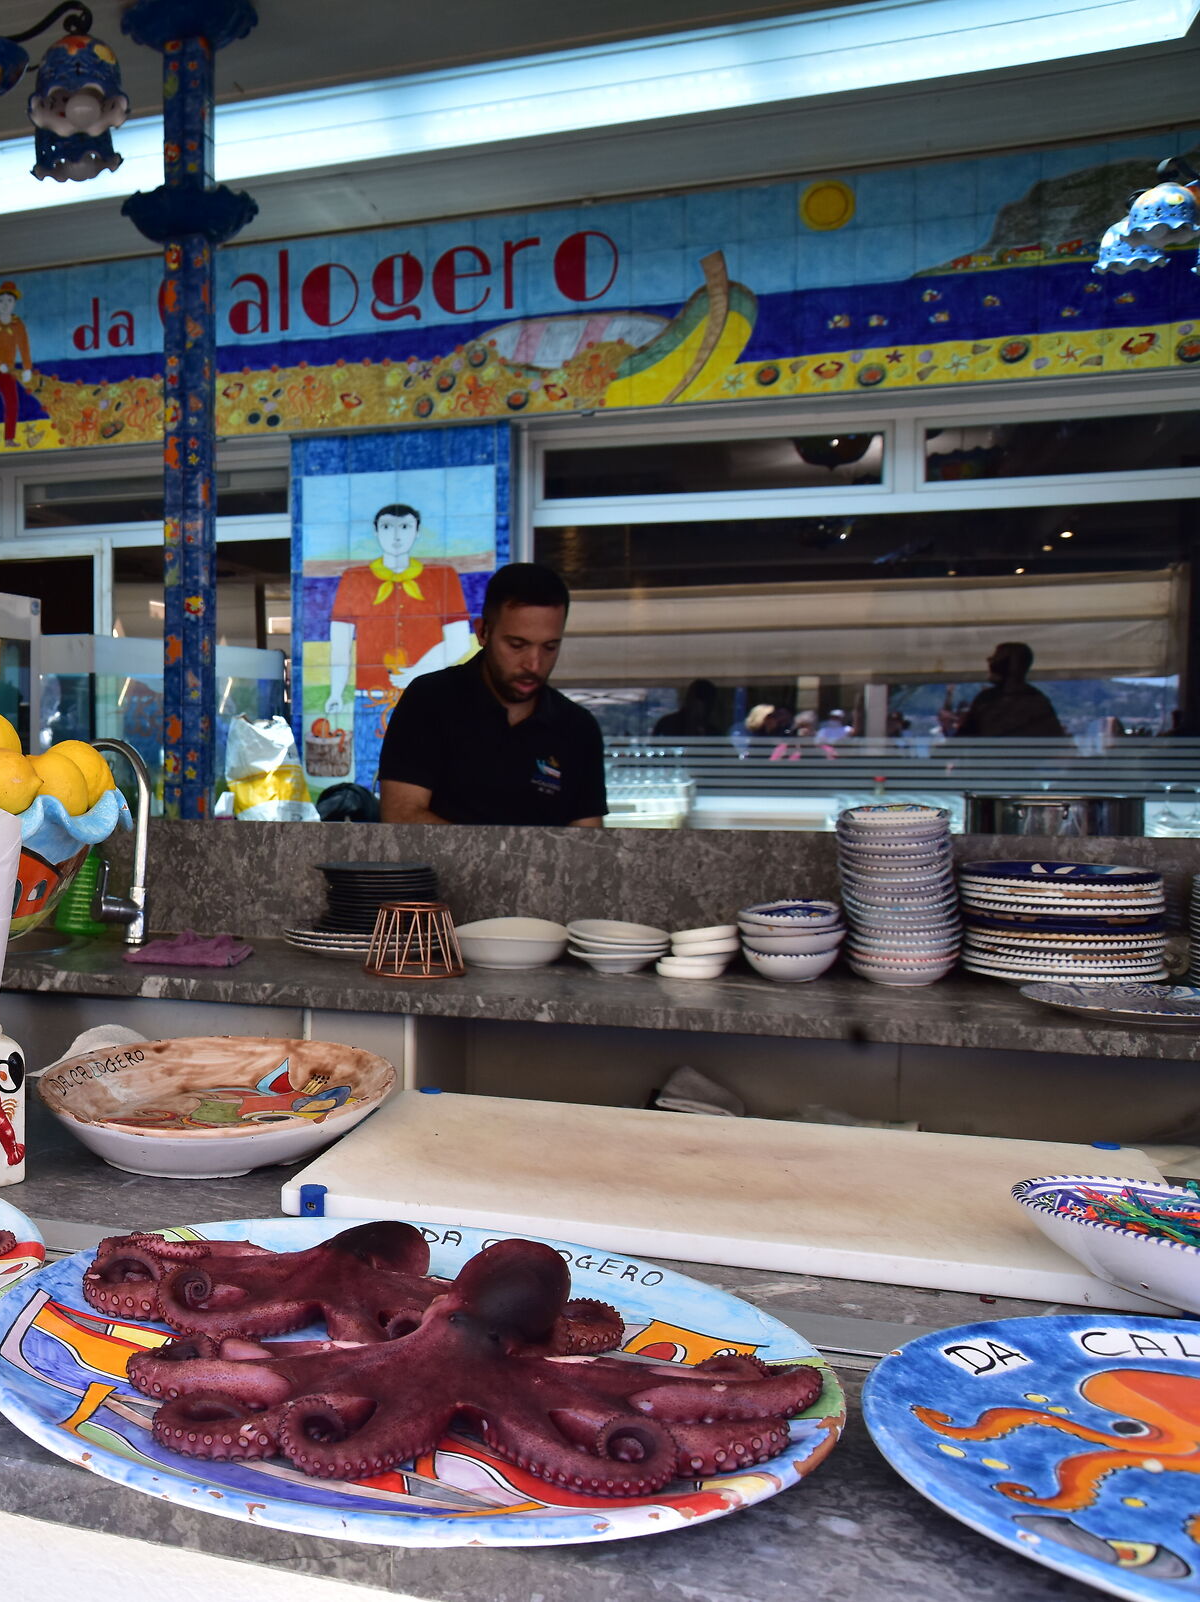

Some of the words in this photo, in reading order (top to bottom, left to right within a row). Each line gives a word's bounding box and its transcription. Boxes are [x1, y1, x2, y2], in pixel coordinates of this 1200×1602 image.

[72, 297, 135, 351] da
[158, 230, 620, 336] alogero
[419, 1227, 463, 1247] DA
[944, 1341, 1029, 1376] DA
